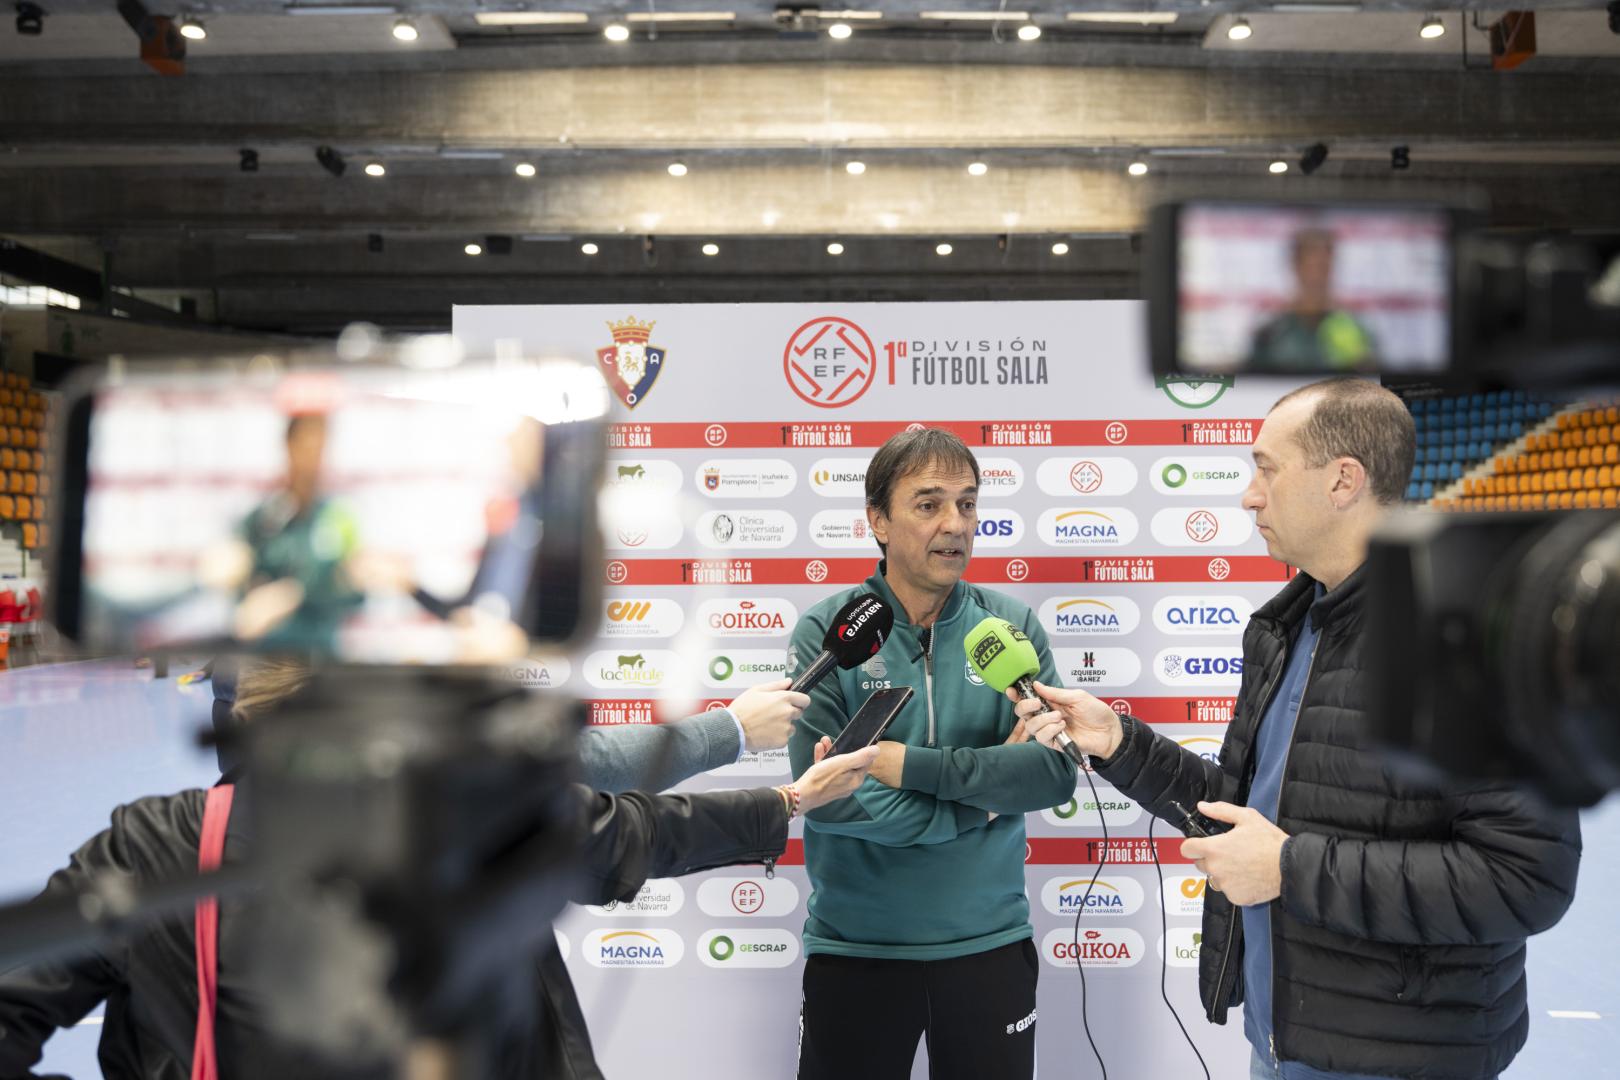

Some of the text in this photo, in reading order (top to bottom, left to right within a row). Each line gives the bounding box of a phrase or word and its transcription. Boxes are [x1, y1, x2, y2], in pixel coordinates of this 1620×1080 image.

[913, 336, 1047, 351] DIVISIÓN
[913, 352, 1049, 385] FÚTBOL SALA
[629, 433, 652, 447] SALA
[829, 432, 852, 446] SALA
[1029, 431, 1052, 444] SALA
[1230, 430, 1253, 443] SALA
[1192, 472, 1241, 481] GESCRAP
[1056, 526, 1119, 537] MAGNA
[1131, 566, 1154, 581] SALA
[709, 613, 786, 629] GOIKOA
[845, 602, 883, 638] Navarra
[1057, 614, 1120, 626] MAGNA
[1167, 607, 1240, 624] ariza
[738, 664, 786, 673] GESCRAP
[1184, 657, 1243, 675] GIOS
[600, 667, 664, 681] lacturale
[862, 681, 892, 690] GIOS
[629, 709, 652, 723] SALA
[1082, 803, 1131, 811] GESCRAP
[1060, 895, 1123, 907] MAGNA
[638, 904, 669, 912] Navarra
[601, 946, 664, 958] MAGNA
[740, 944, 788, 953] GESCRAP
[1053, 942, 1131, 959] GOIKOA
